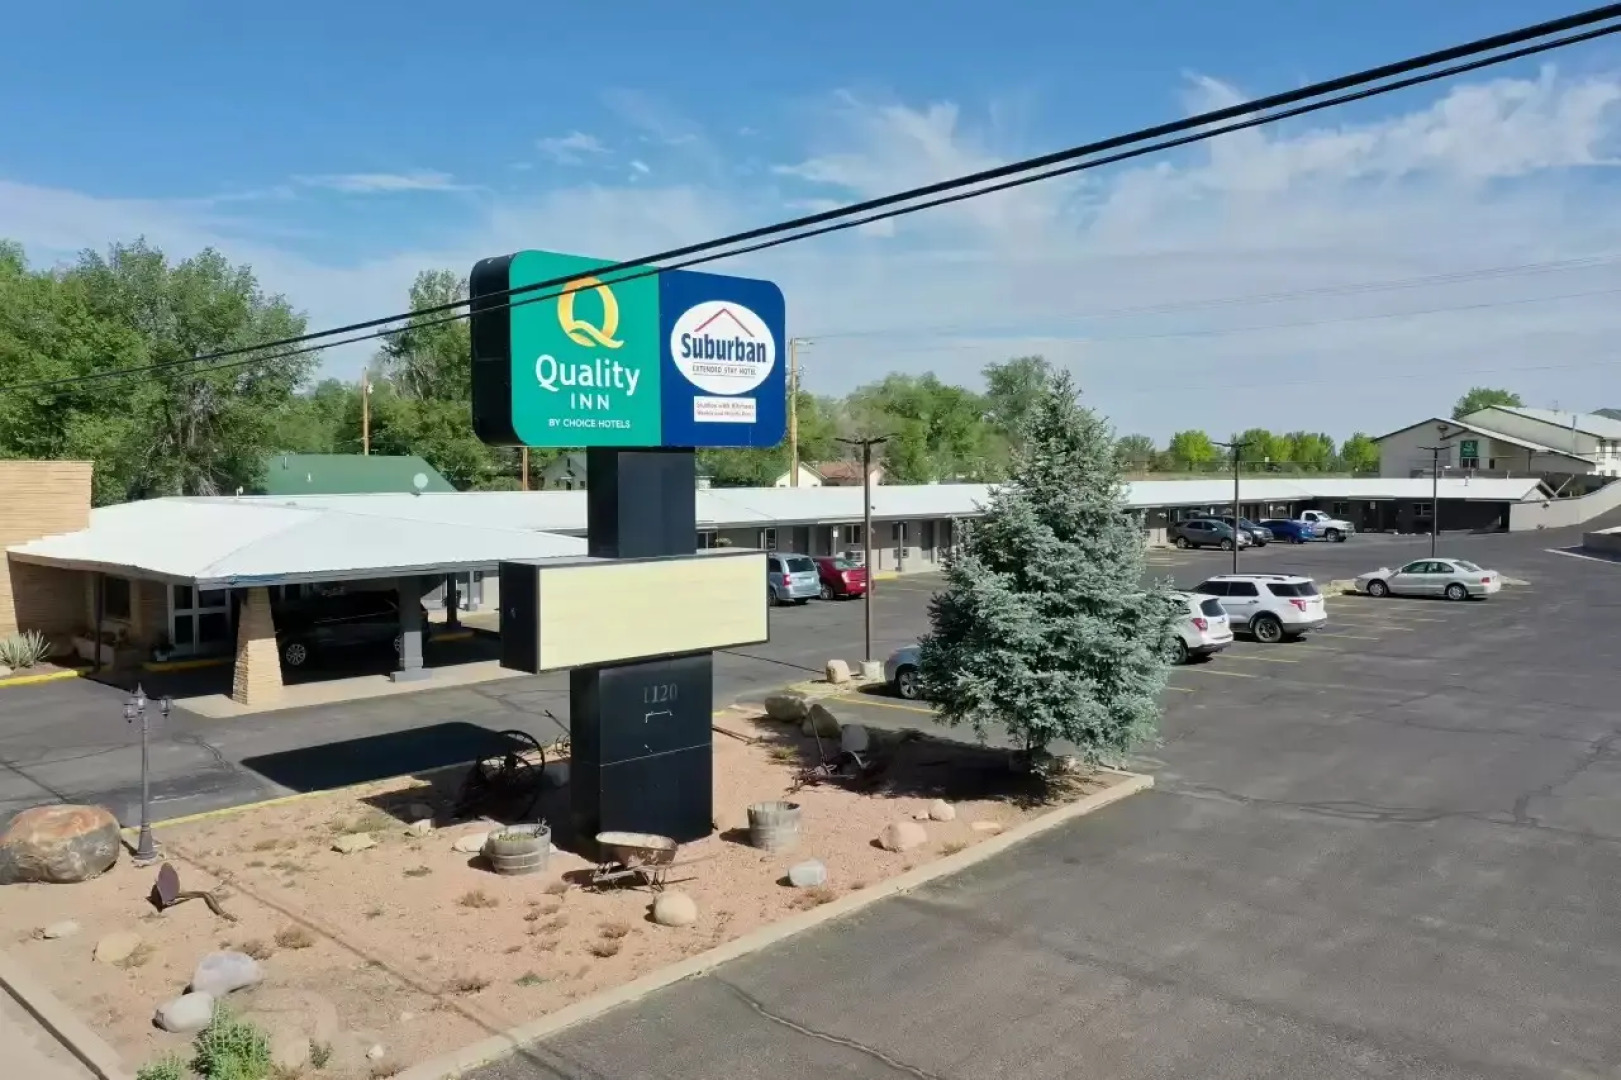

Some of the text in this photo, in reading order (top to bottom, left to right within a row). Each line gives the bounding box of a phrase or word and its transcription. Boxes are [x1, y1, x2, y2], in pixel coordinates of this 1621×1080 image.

[557, 275, 625, 348] Q
[681, 333, 766, 363] Suburban
[536, 354, 640, 396] Quality
[570, 392, 610, 410] INN
[548, 418, 631, 429] BY CHOICE HOTELS
[643, 683, 678, 703] 1120
